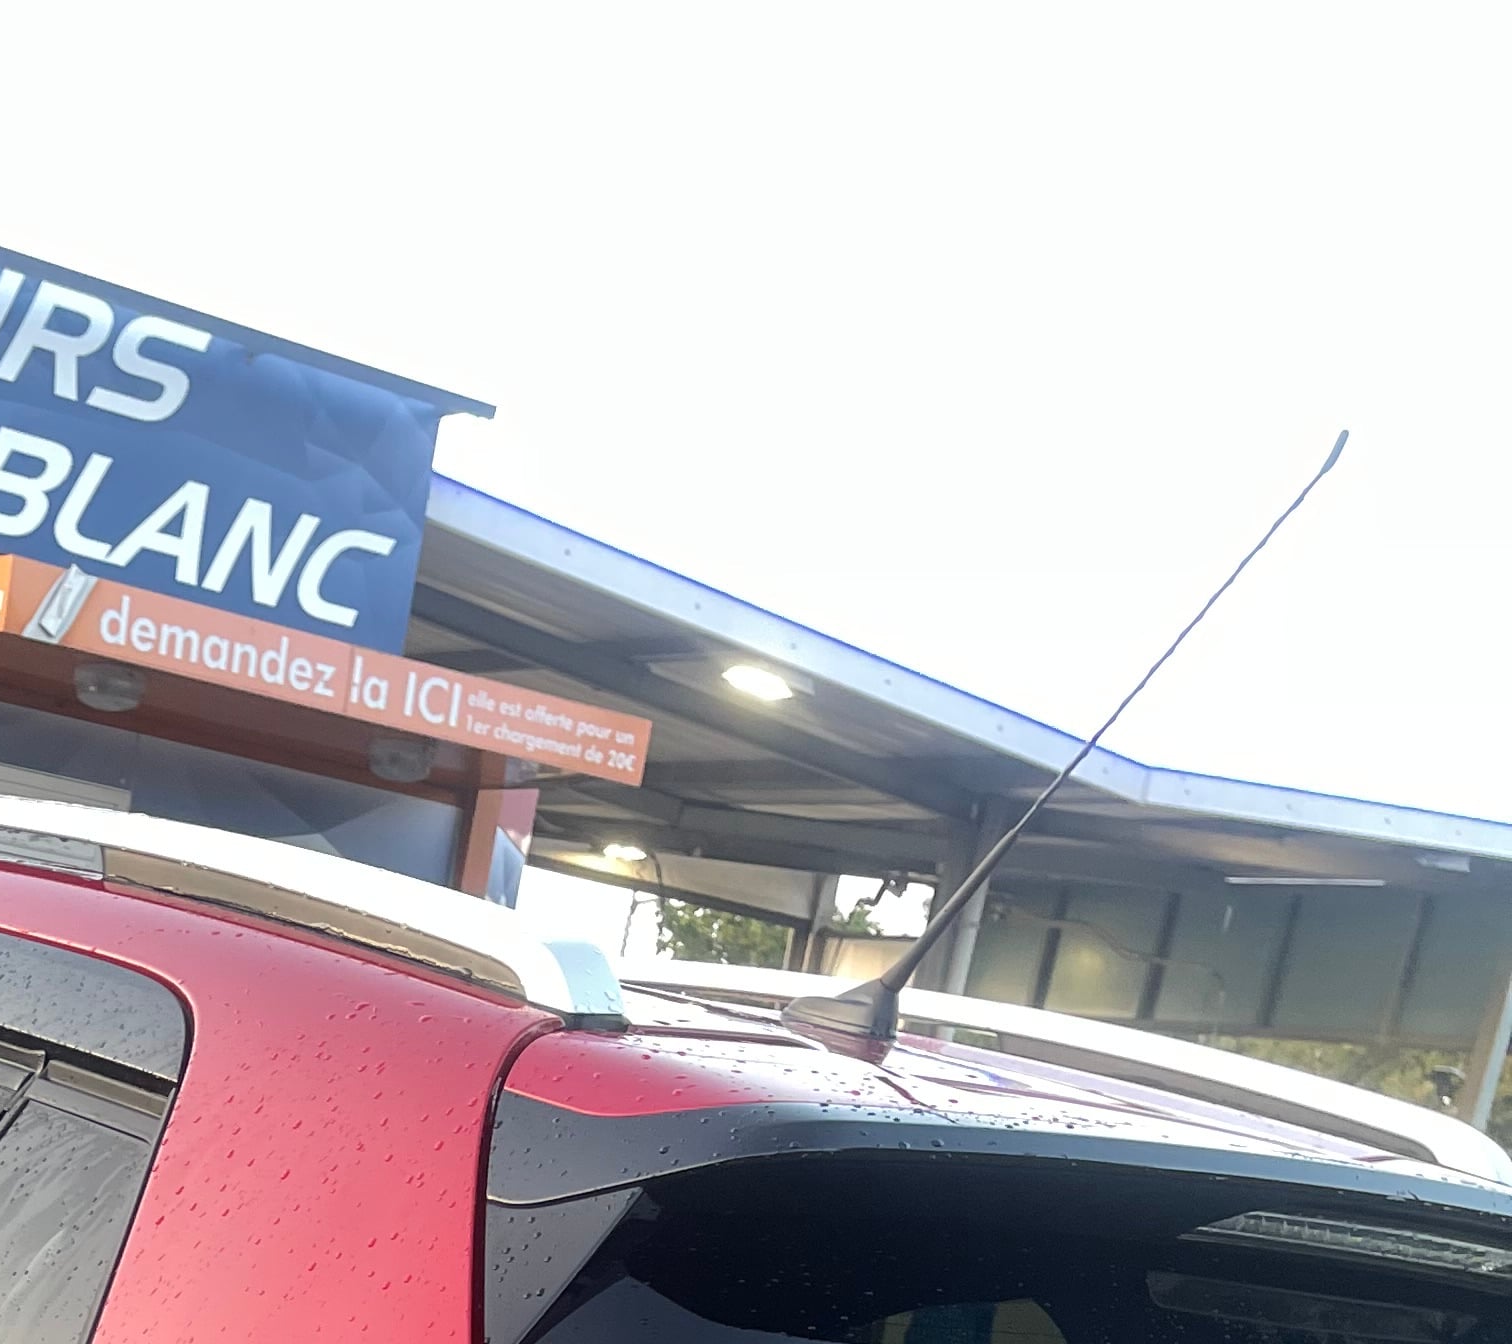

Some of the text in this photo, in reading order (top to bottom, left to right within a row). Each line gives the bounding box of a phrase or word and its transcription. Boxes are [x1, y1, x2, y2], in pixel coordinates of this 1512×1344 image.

[99, 594, 462, 727] demandez la ICI
[466, 714, 637, 772] 1er chargement de 20€
[467, 690, 635, 745] elle est offerte pour un
